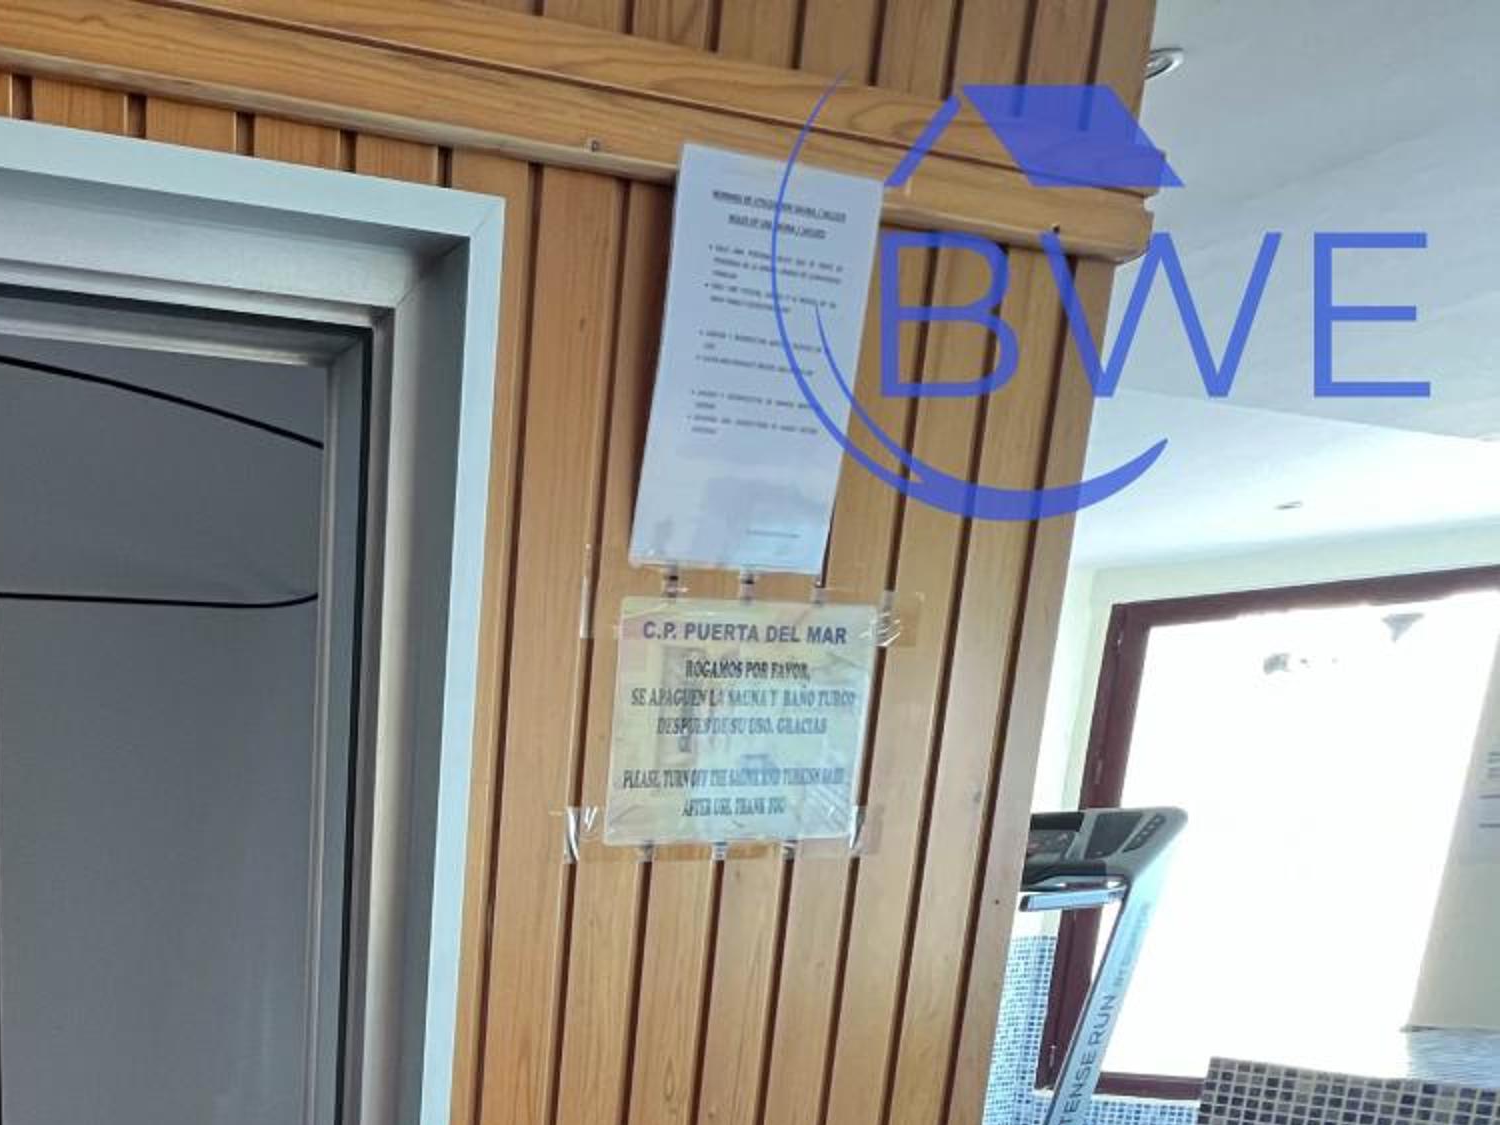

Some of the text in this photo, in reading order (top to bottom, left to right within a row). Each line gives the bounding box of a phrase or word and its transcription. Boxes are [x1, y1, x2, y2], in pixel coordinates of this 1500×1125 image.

[643, 621, 847, 645] C.P. PUERTA DEL MAR
[685, 659, 742, 679] ROGAMOS
[745, 661, 768, 679] POR
[631, 687, 647, 706] SE
[649, 687, 706, 706] APAGUEN
[1087, 994, 1116, 1046] RUN
